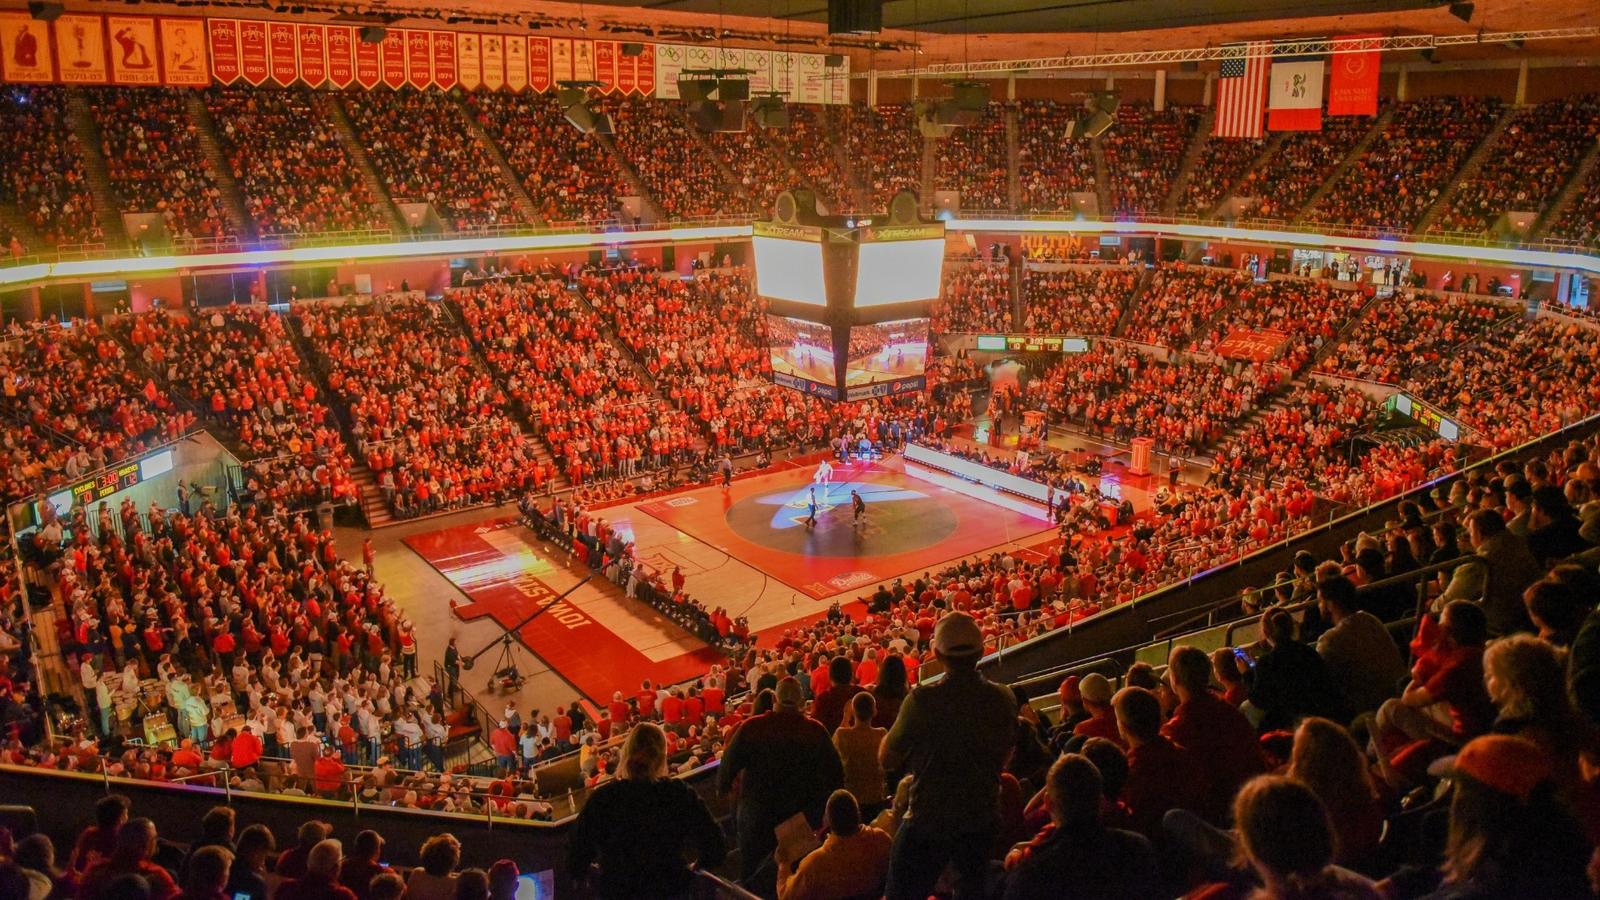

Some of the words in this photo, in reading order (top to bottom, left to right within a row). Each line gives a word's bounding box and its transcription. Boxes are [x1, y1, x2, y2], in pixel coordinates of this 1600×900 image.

[304, 68, 323, 76] 1970
[765, 226, 804, 237] XTREAM
[877, 228, 926, 240] XTREAM
[1020, 235, 1082, 249] HILTON
[1225, 340, 1275, 354] STATE
[102, 471, 118, 487] 3:00
[74, 480, 96, 495] CYCLONES
[99, 486, 114, 497] PERIOD
[536, 594, 592, 629] IOWA
